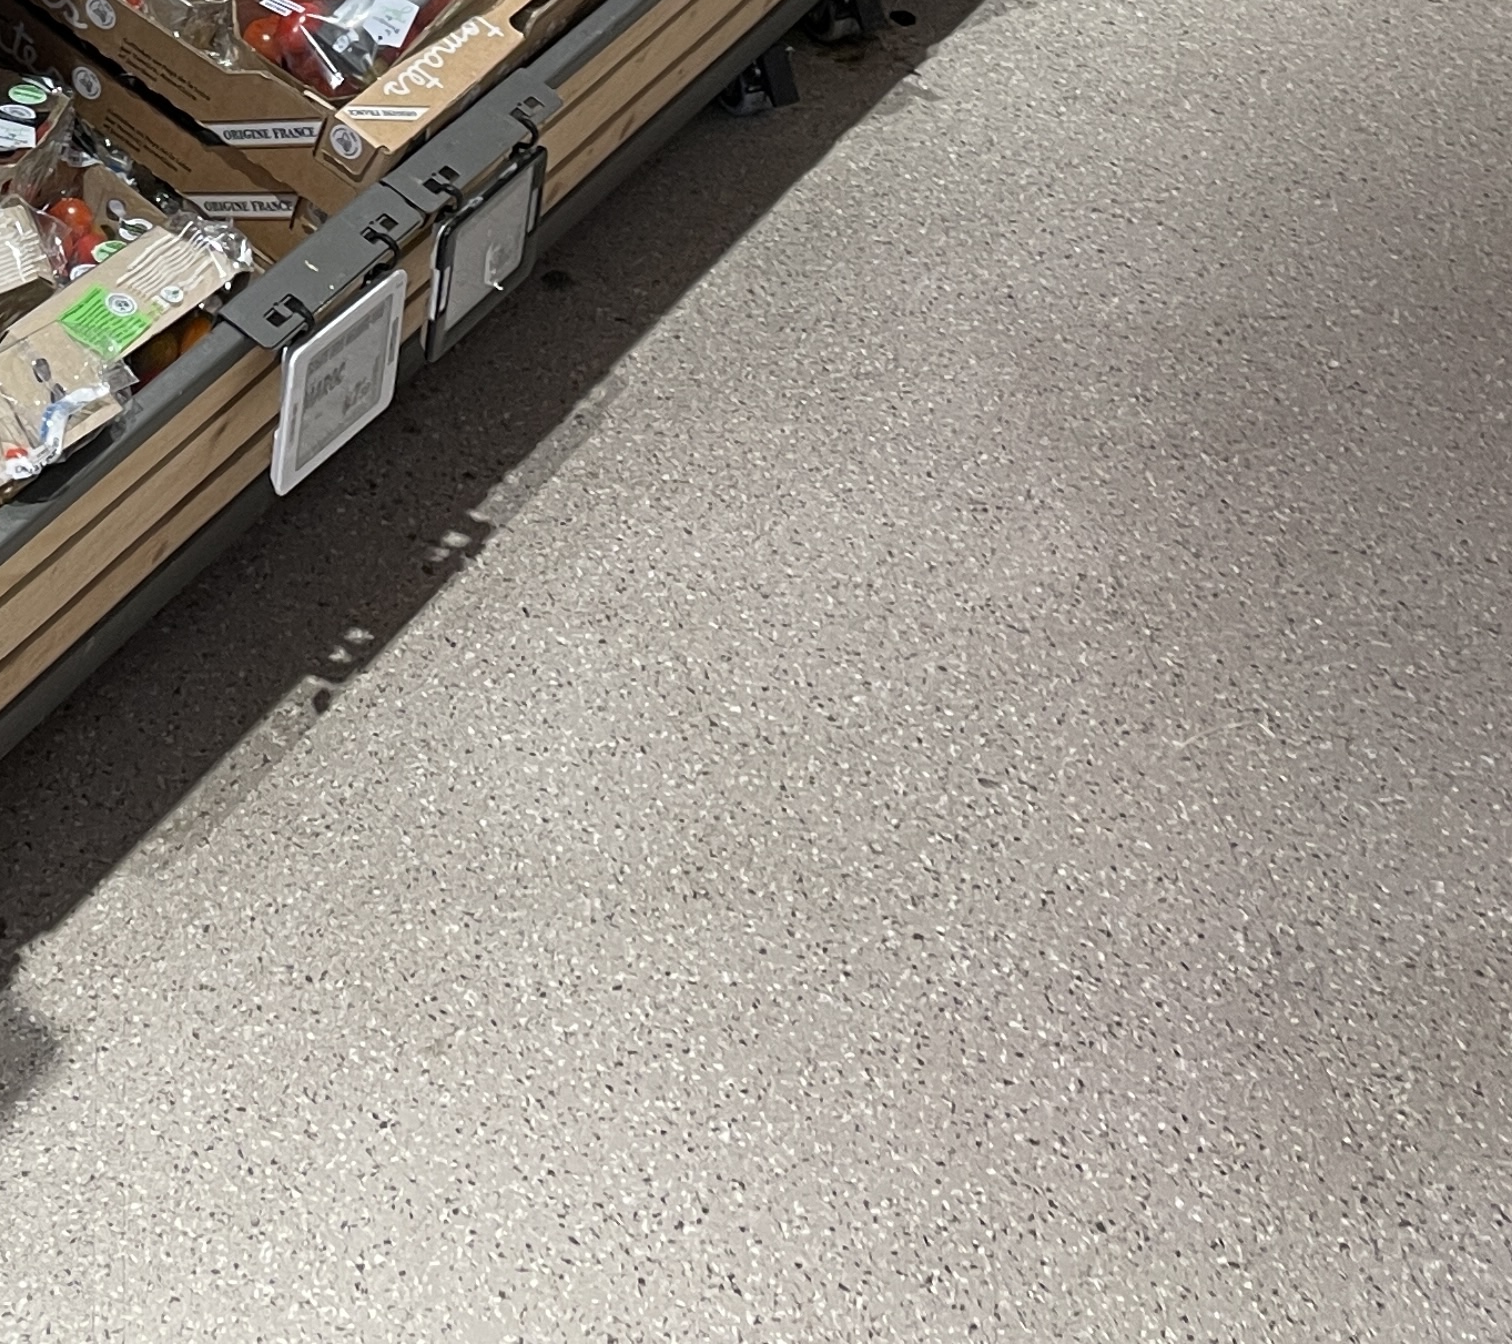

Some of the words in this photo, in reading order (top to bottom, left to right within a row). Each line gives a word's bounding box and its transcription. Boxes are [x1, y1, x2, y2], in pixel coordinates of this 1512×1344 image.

[383, 15, 504, 96] tomates
[223, 127, 272, 142] ORIGINE
[273, 125, 316, 139] FRANCE
[203, 200, 250, 212] ORIGINE
[252, 199, 293, 212] FRANCE
